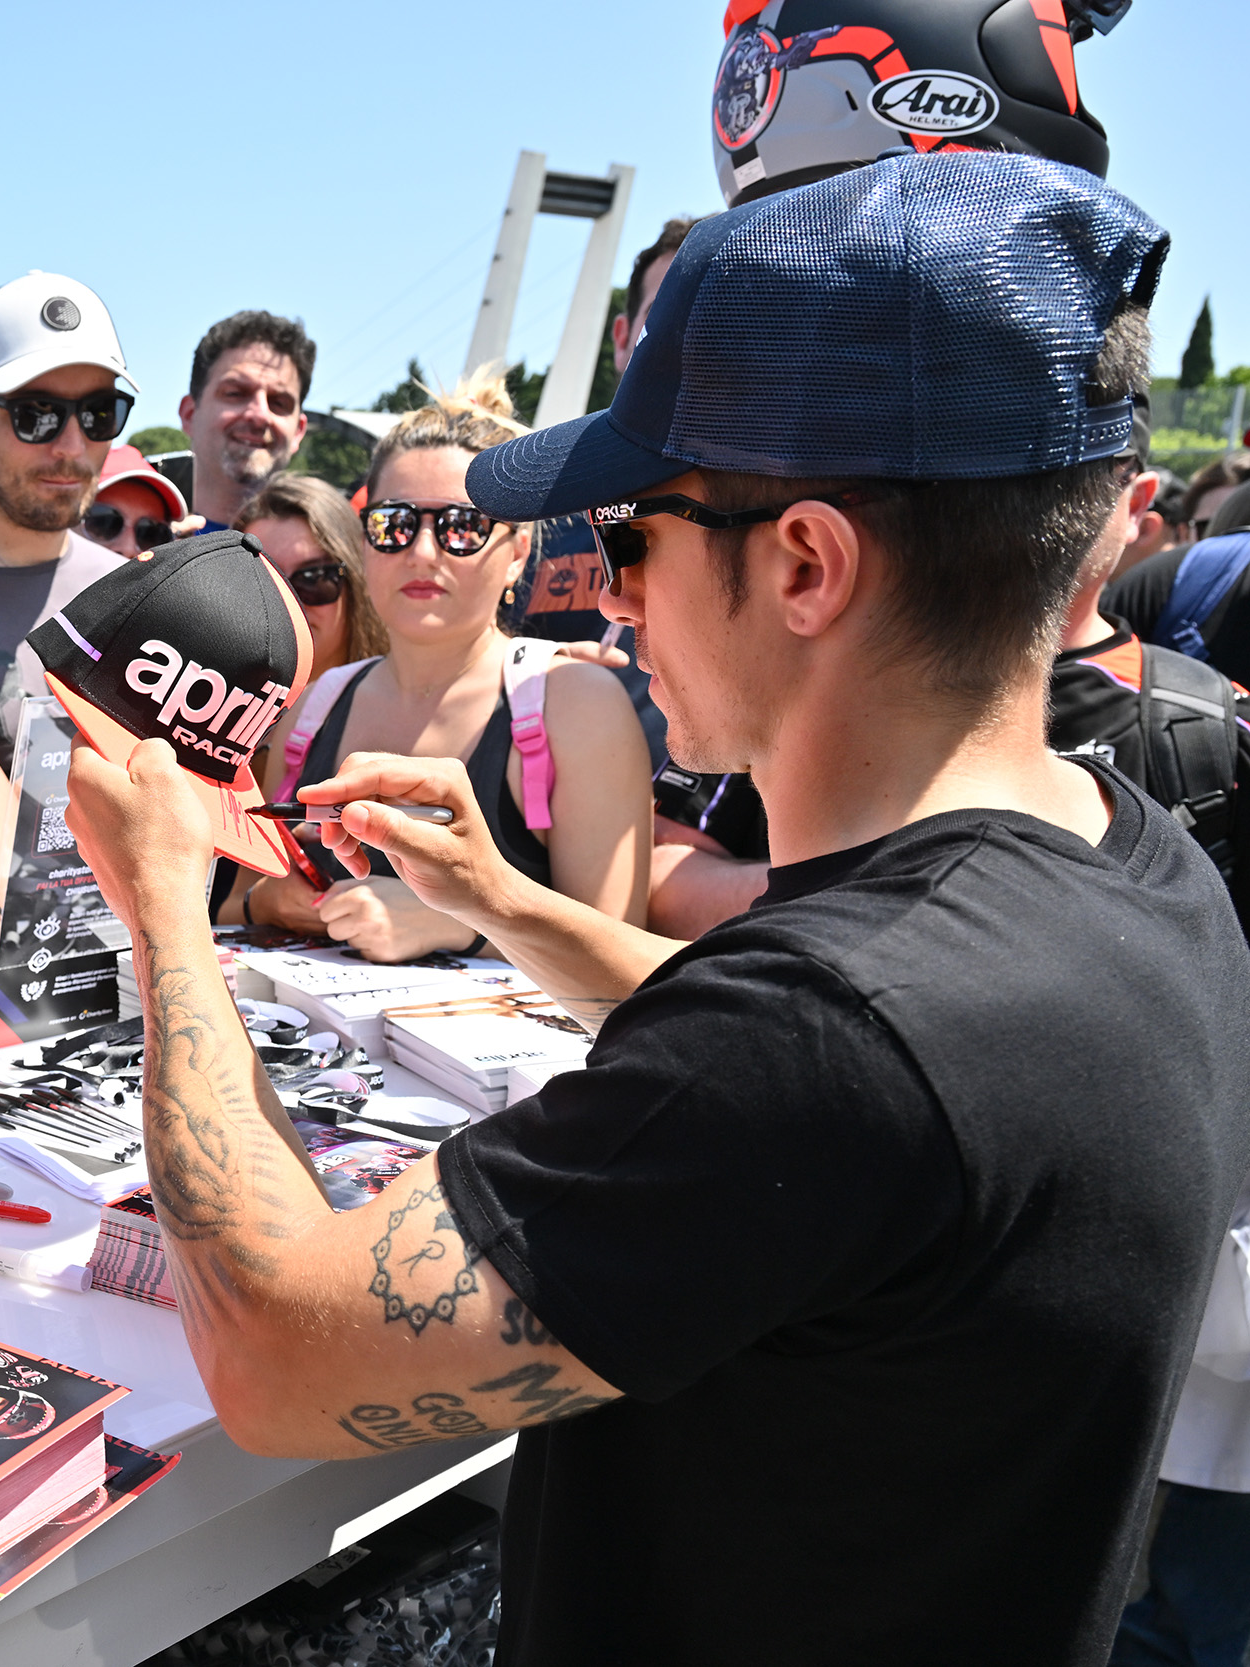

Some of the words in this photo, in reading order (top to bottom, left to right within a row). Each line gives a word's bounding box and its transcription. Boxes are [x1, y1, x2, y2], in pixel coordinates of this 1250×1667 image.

[878, 80, 984, 118] Arai
[595, 503, 637, 520] OAKLEY
[40, 1358, 116, 1389] ALEIX
